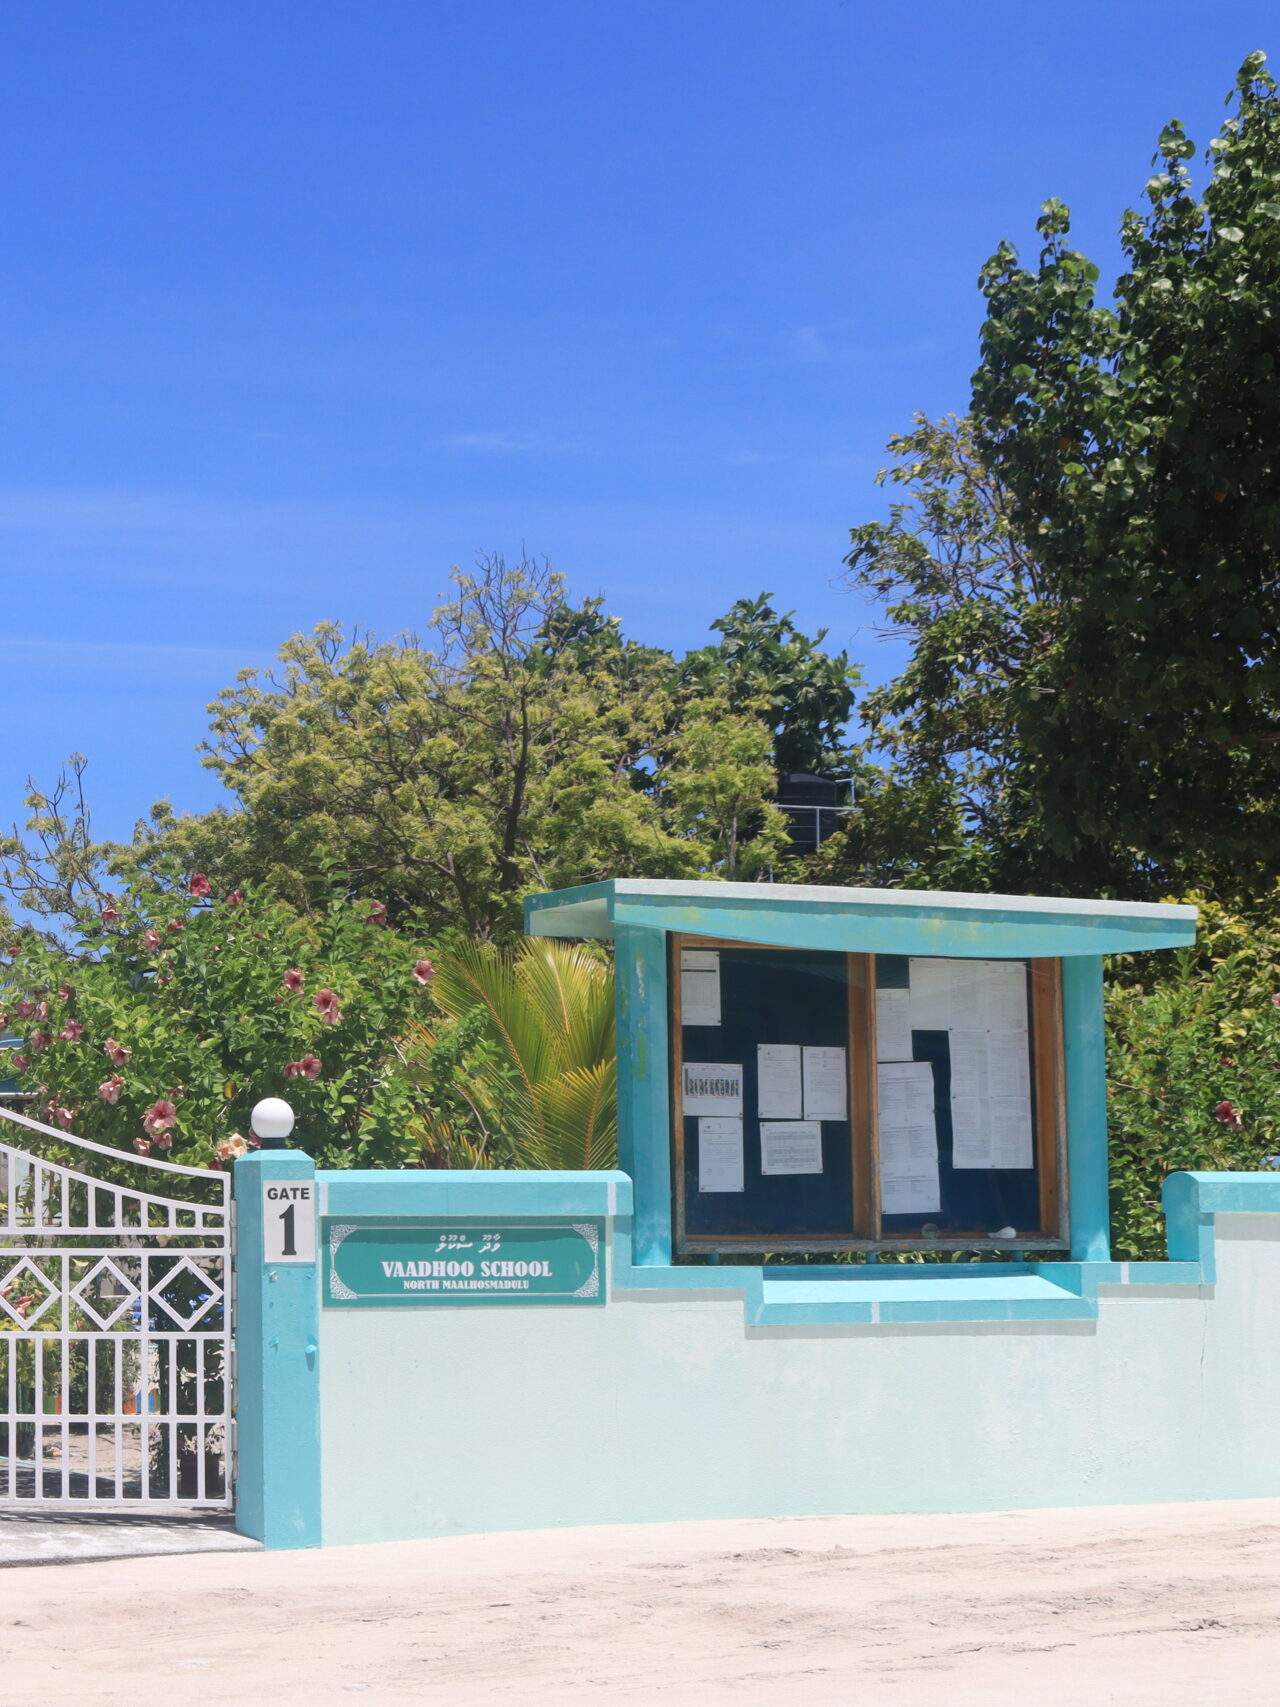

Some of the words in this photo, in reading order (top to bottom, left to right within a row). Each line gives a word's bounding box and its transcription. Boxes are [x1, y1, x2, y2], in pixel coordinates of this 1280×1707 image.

[267, 1187, 310, 1200] GATE
[278, 1203, 297, 1256] 1
[381, 1260, 475, 1278] VAADHOO
[480, 1260, 553, 1277] SCHOOL
[403, 1279, 440, 1290] NORTH
[442, 1279, 530, 1290] MAALHOSMADULU
